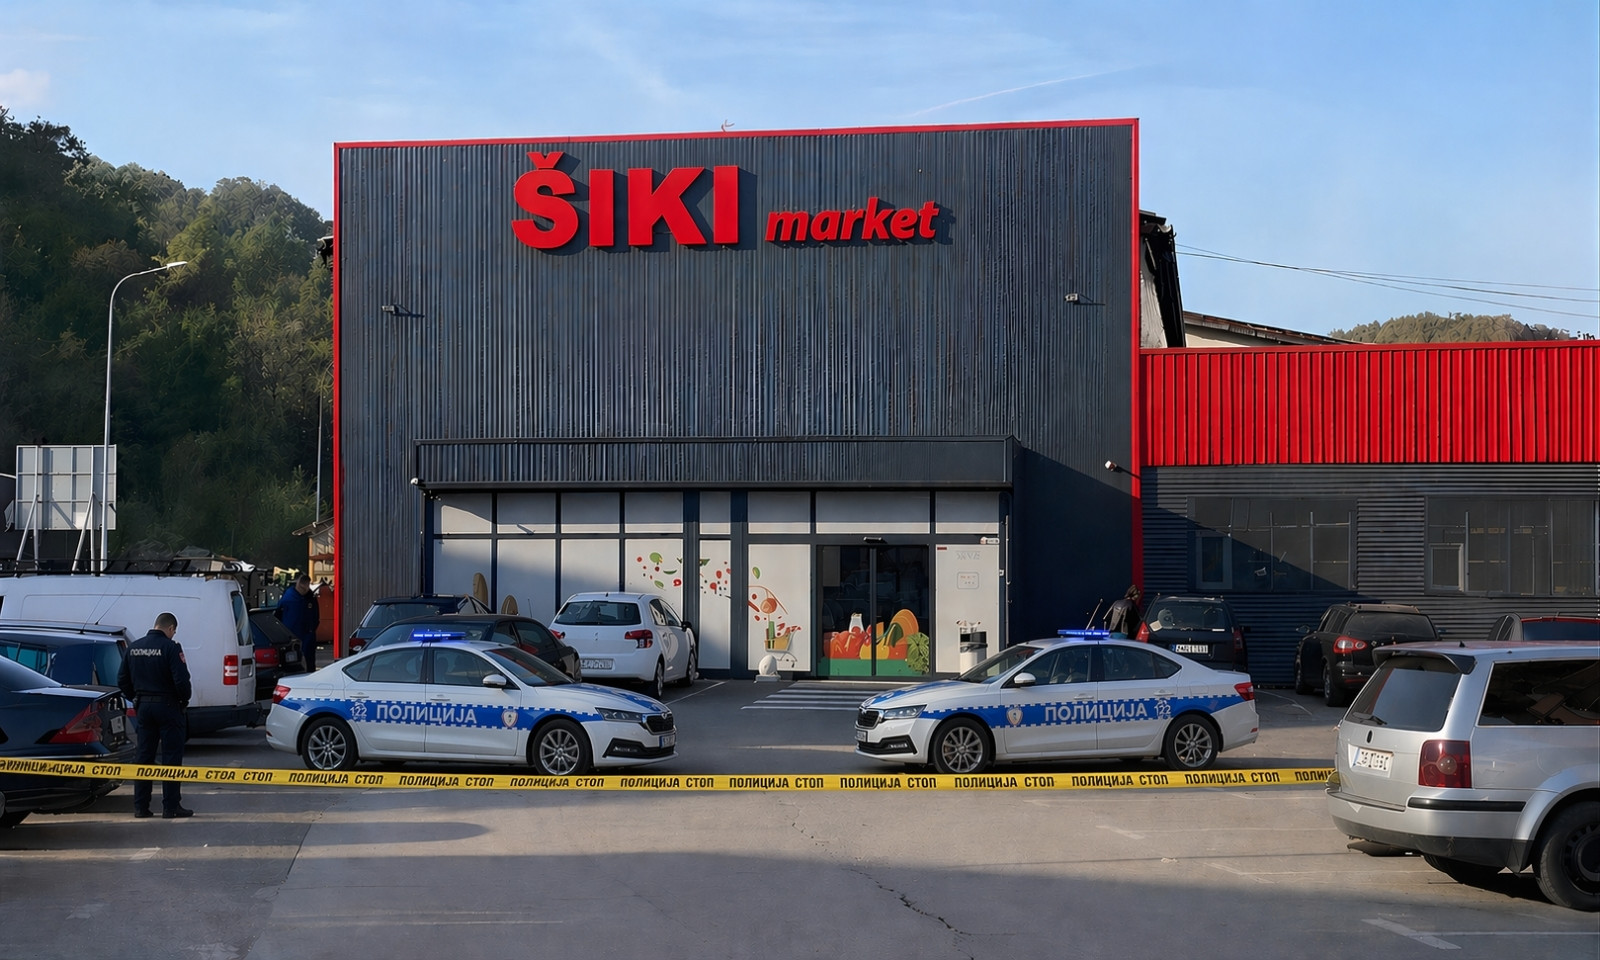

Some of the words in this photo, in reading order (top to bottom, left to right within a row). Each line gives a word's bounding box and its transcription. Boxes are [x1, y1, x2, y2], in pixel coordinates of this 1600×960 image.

[511, 151, 739, 249] ŠIKI
[765, 197, 939, 242] market
[376, 704, 477, 724] ПОЛИЦИЈА
[1045, 702, 1147, 722] ПОЛИЦИЈА
[92, 765, 122, 776] СТОП
[136, 768, 199, 780] ПОЛИЦИЈА
[243, 771, 273, 781] СТОП
[288, 772, 349, 785] ПОЛИЦИЈА
[354, 774, 384, 785] СТОП
[399, 775, 459, 788] ПОЛИЦИЈА
[465, 777, 494, 787] СТОП
[510, 777, 569, 788] ПОЛИЦИЈА
[575, 777, 605, 787] СТОП
[620, 778, 680, 789] ПОЛИЦИЈА
[686, 777, 714, 788] СТОП
[729, 777, 789, 789] ПОЛИЦИЈА
[795, 777, 824, 788] СТОП
[840, 777, 901, 789] ПОЛИЦИЈА
[907, 777, 937, 788] СТОП
[954, 777, 1018, 789] ПОЛИЦИЈА
[1024, 776, 1054, 788] СТОП
[1071, 775, 1134, 788] ПОЛИЦИЈА
[1139, 774, 1169, 786] СТОП
[1184, 772, 1246, 786] ПОЛИЦИЈА
[1250, 772, 1280, 783] СТОП
